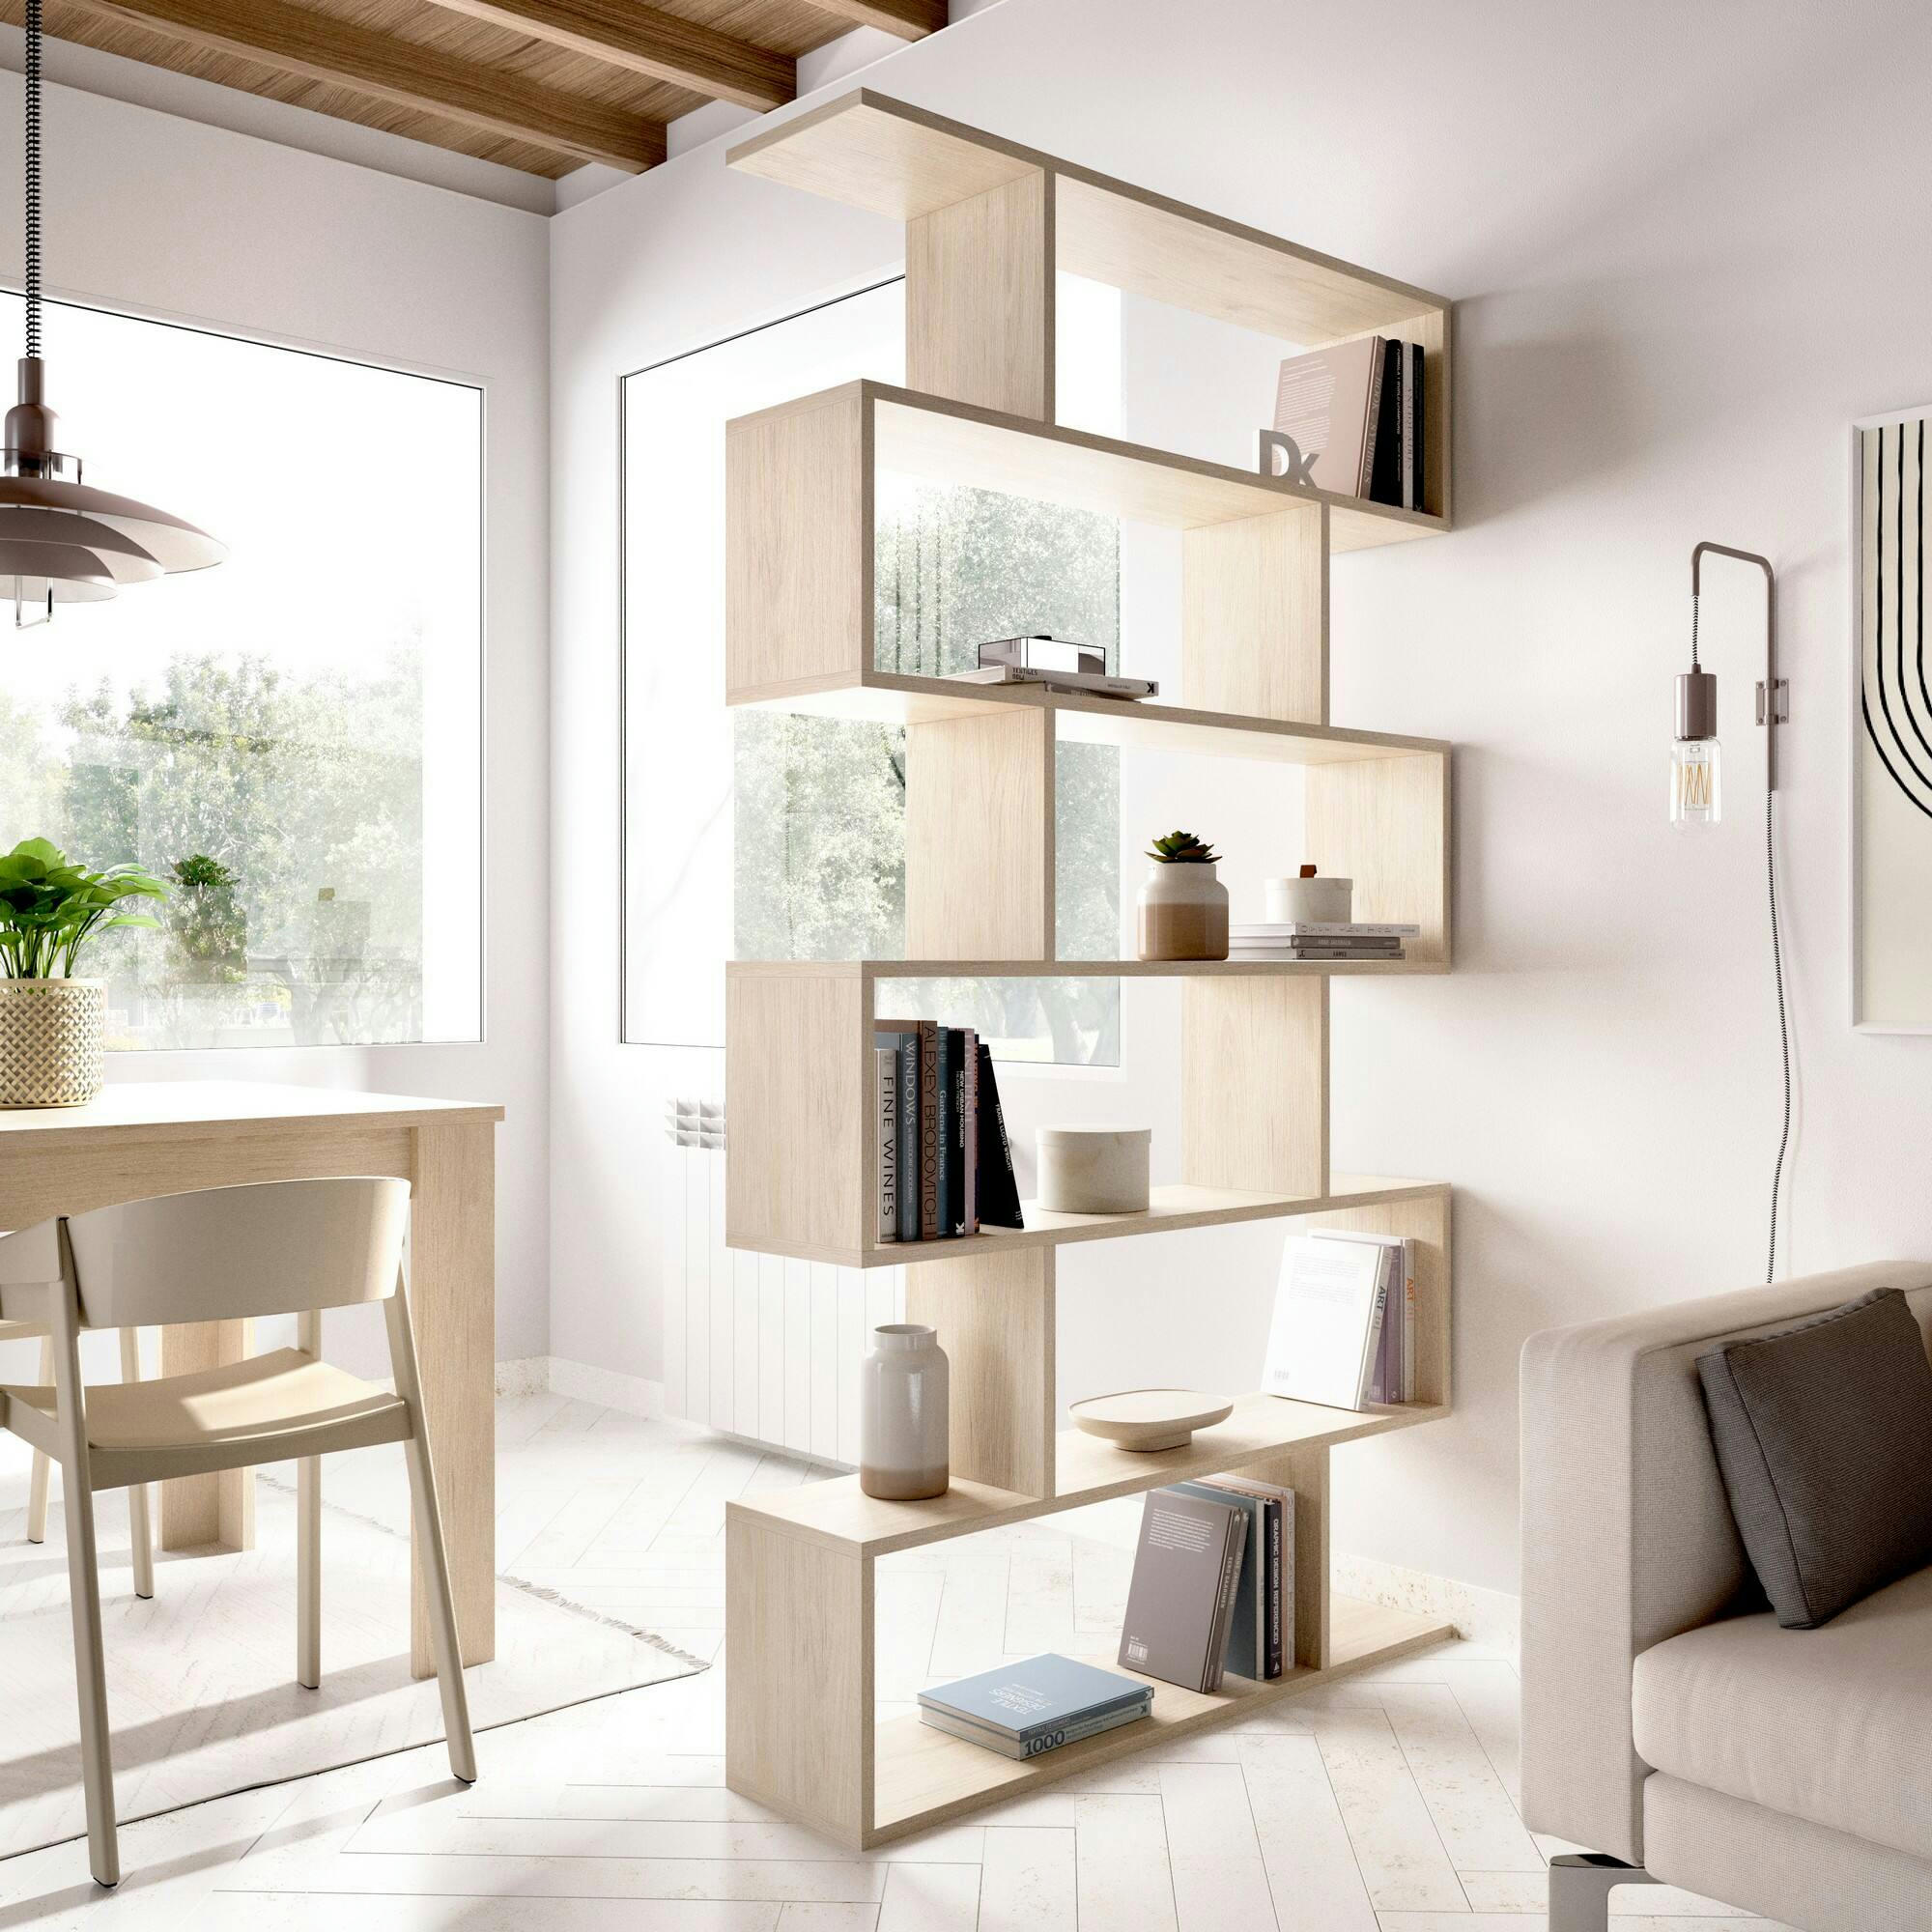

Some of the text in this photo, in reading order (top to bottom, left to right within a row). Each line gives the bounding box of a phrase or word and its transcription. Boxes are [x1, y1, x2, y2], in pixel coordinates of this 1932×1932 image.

[1363, 422, 1378, 484] SYMBOLS
[883, 1076, 894, 1128] FINE
[905, 1039, 916, 1125] WINDOWS
[924, 1026, 937, 1226] ALEXEY BRODOVITCH
[940, 1134, 947, 1144] in
[995, 1103, 1013, 1171] FRANK LLOYD WRIGHT
[883, 1138, 894, 1216] WINES
[1377, 1286, 1386, 1312] ART
[1024, 1730, 1065, 1756] 1000
